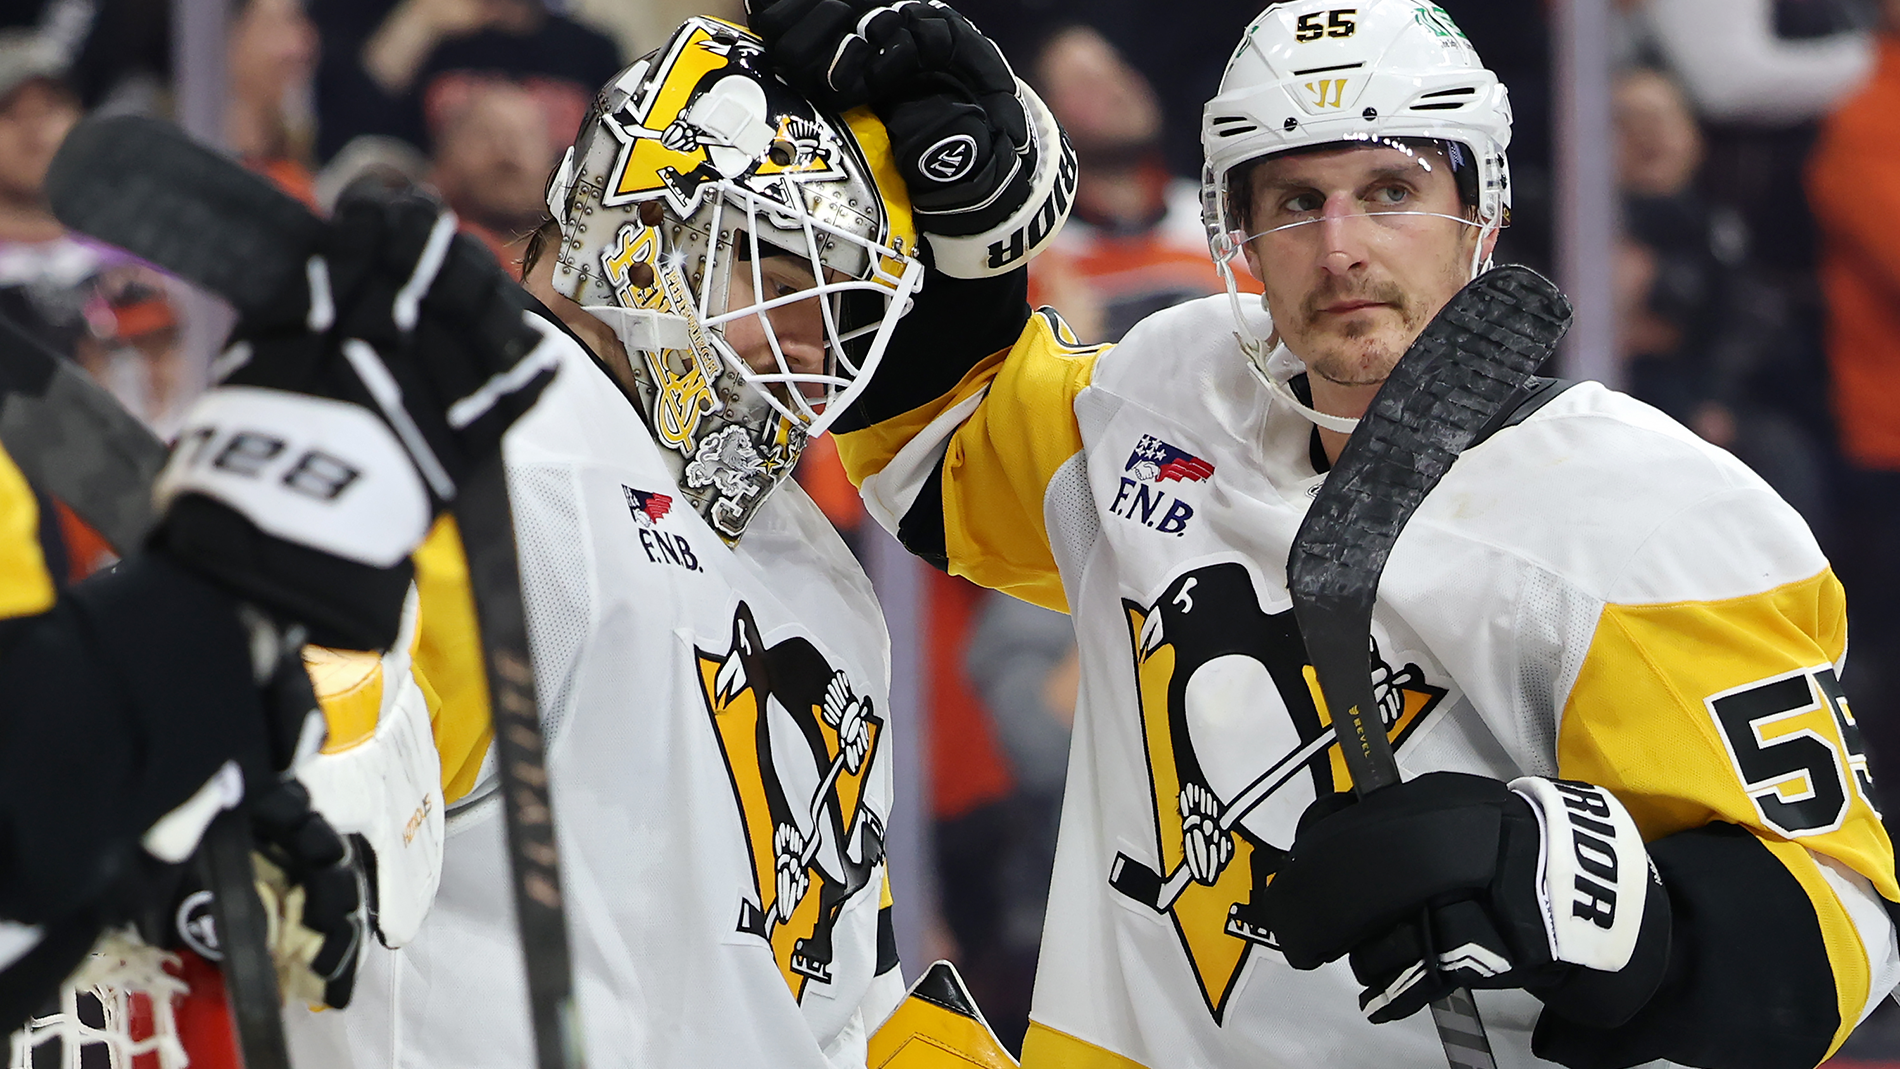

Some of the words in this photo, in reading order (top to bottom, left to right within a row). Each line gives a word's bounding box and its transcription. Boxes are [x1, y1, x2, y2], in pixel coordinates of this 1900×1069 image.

[1295, 8, 1358, 43] 55
[986, 129, 1078, 269] RIOR
[1108, 476, 1194, 537] F.N.B.
[637, 527, 704, 574] F.N.B.
[1552, 777, 1619, 931] RIOR
